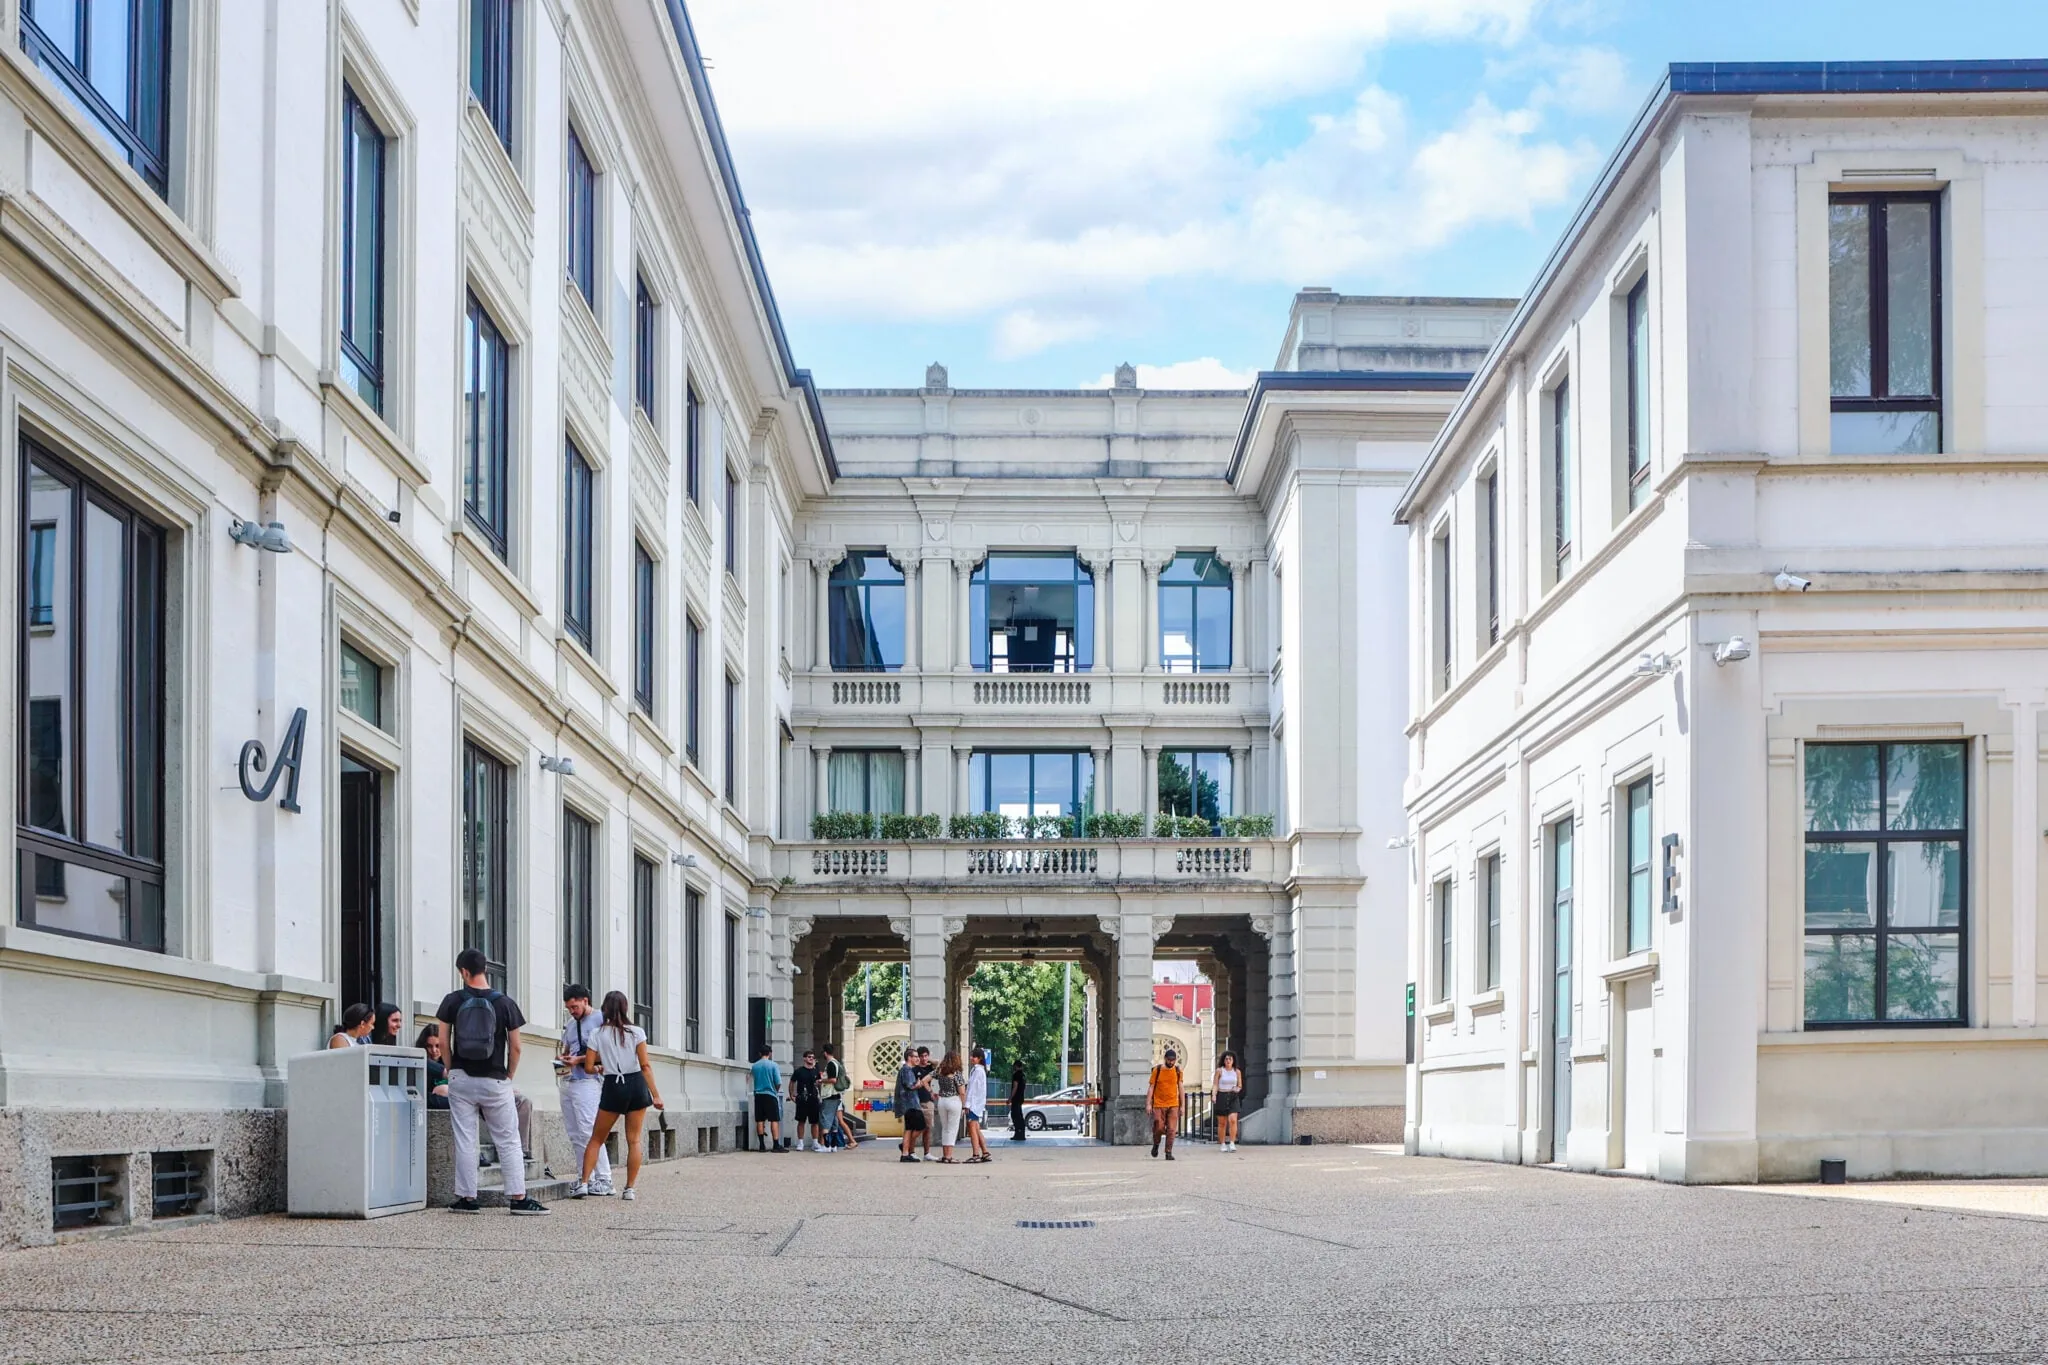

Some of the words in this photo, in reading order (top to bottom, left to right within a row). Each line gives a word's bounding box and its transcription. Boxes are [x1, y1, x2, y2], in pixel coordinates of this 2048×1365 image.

[239, 706, 308, 815] A
[1661, 832, 1679, 915] E
[1407, 985, 1415, 1017] E
